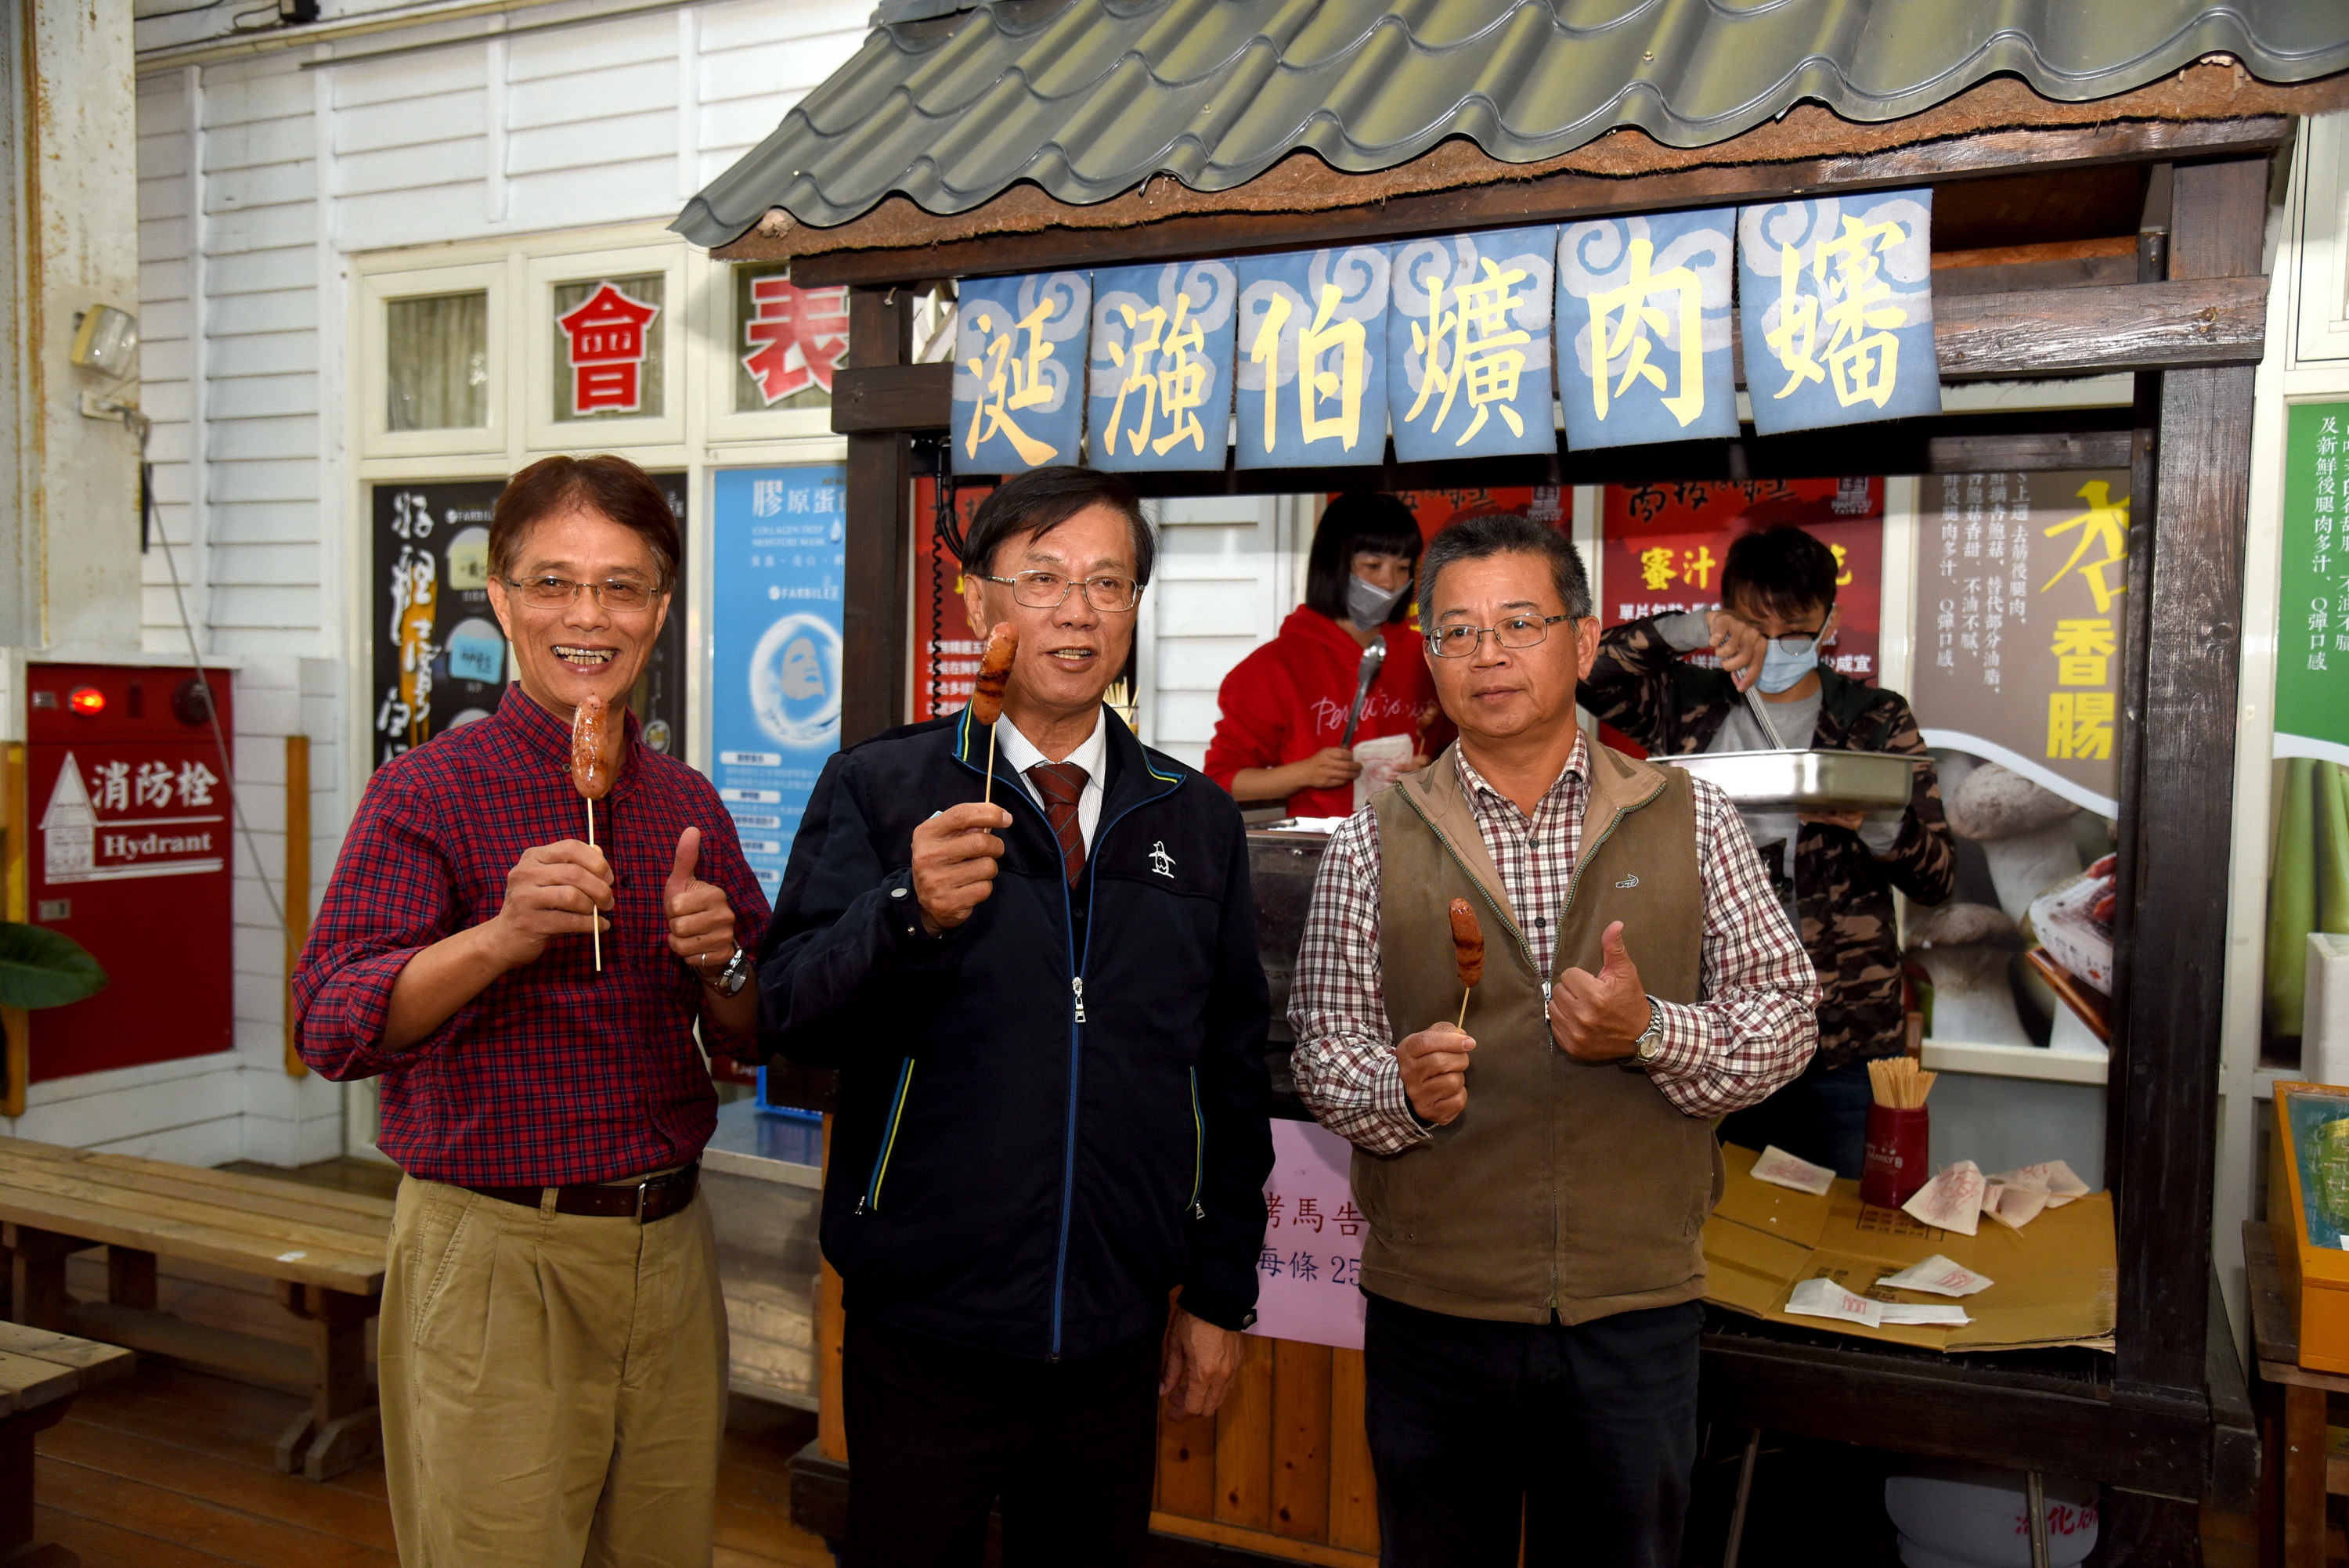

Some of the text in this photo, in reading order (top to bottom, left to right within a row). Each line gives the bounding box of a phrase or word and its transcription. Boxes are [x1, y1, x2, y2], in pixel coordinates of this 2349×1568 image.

[557, 280, 660, 414] 會
[1640, 546, 1716, 590] 蜜汁
[2046, 618, 2117, 759] 香腸
[92, 760, 219, 812] 消防栓
[103, 832, 213, 860] Hydrant
